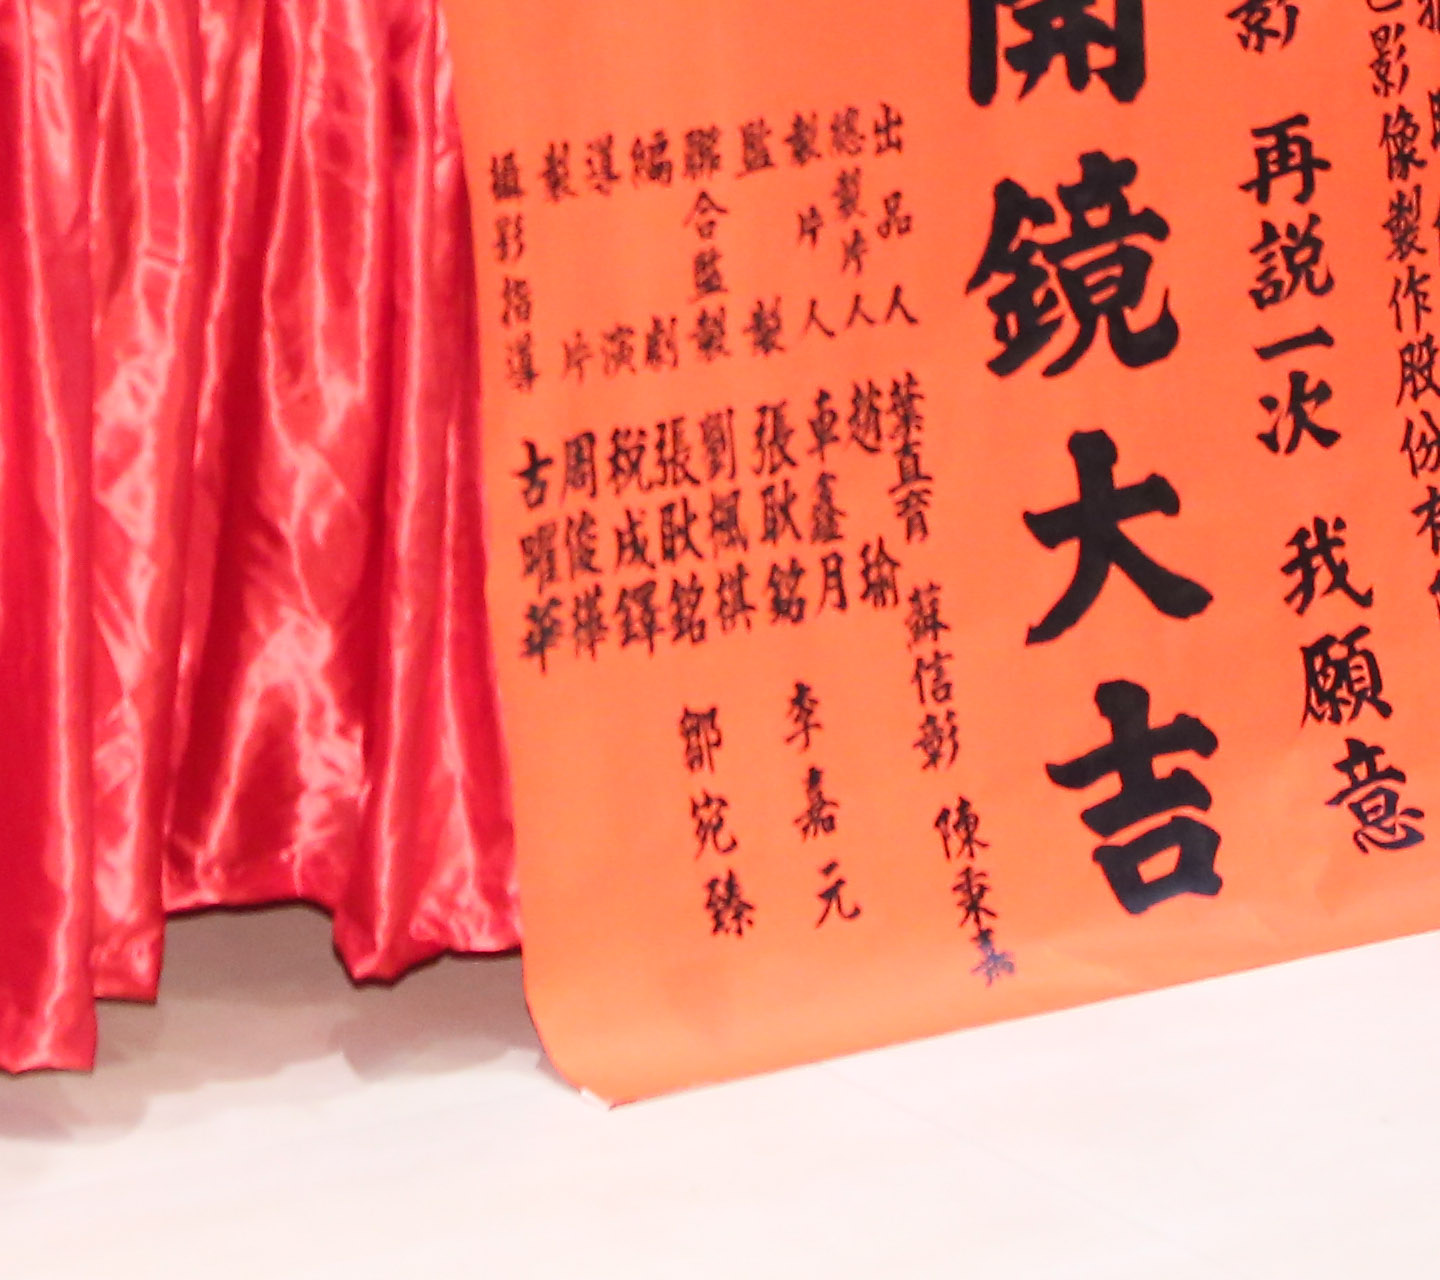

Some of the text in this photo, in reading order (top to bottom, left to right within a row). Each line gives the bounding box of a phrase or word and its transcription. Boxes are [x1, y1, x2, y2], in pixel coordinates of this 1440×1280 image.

[873, 102, 919, 326] 出品人
[1280, 514, 1426, 854] 我願意
